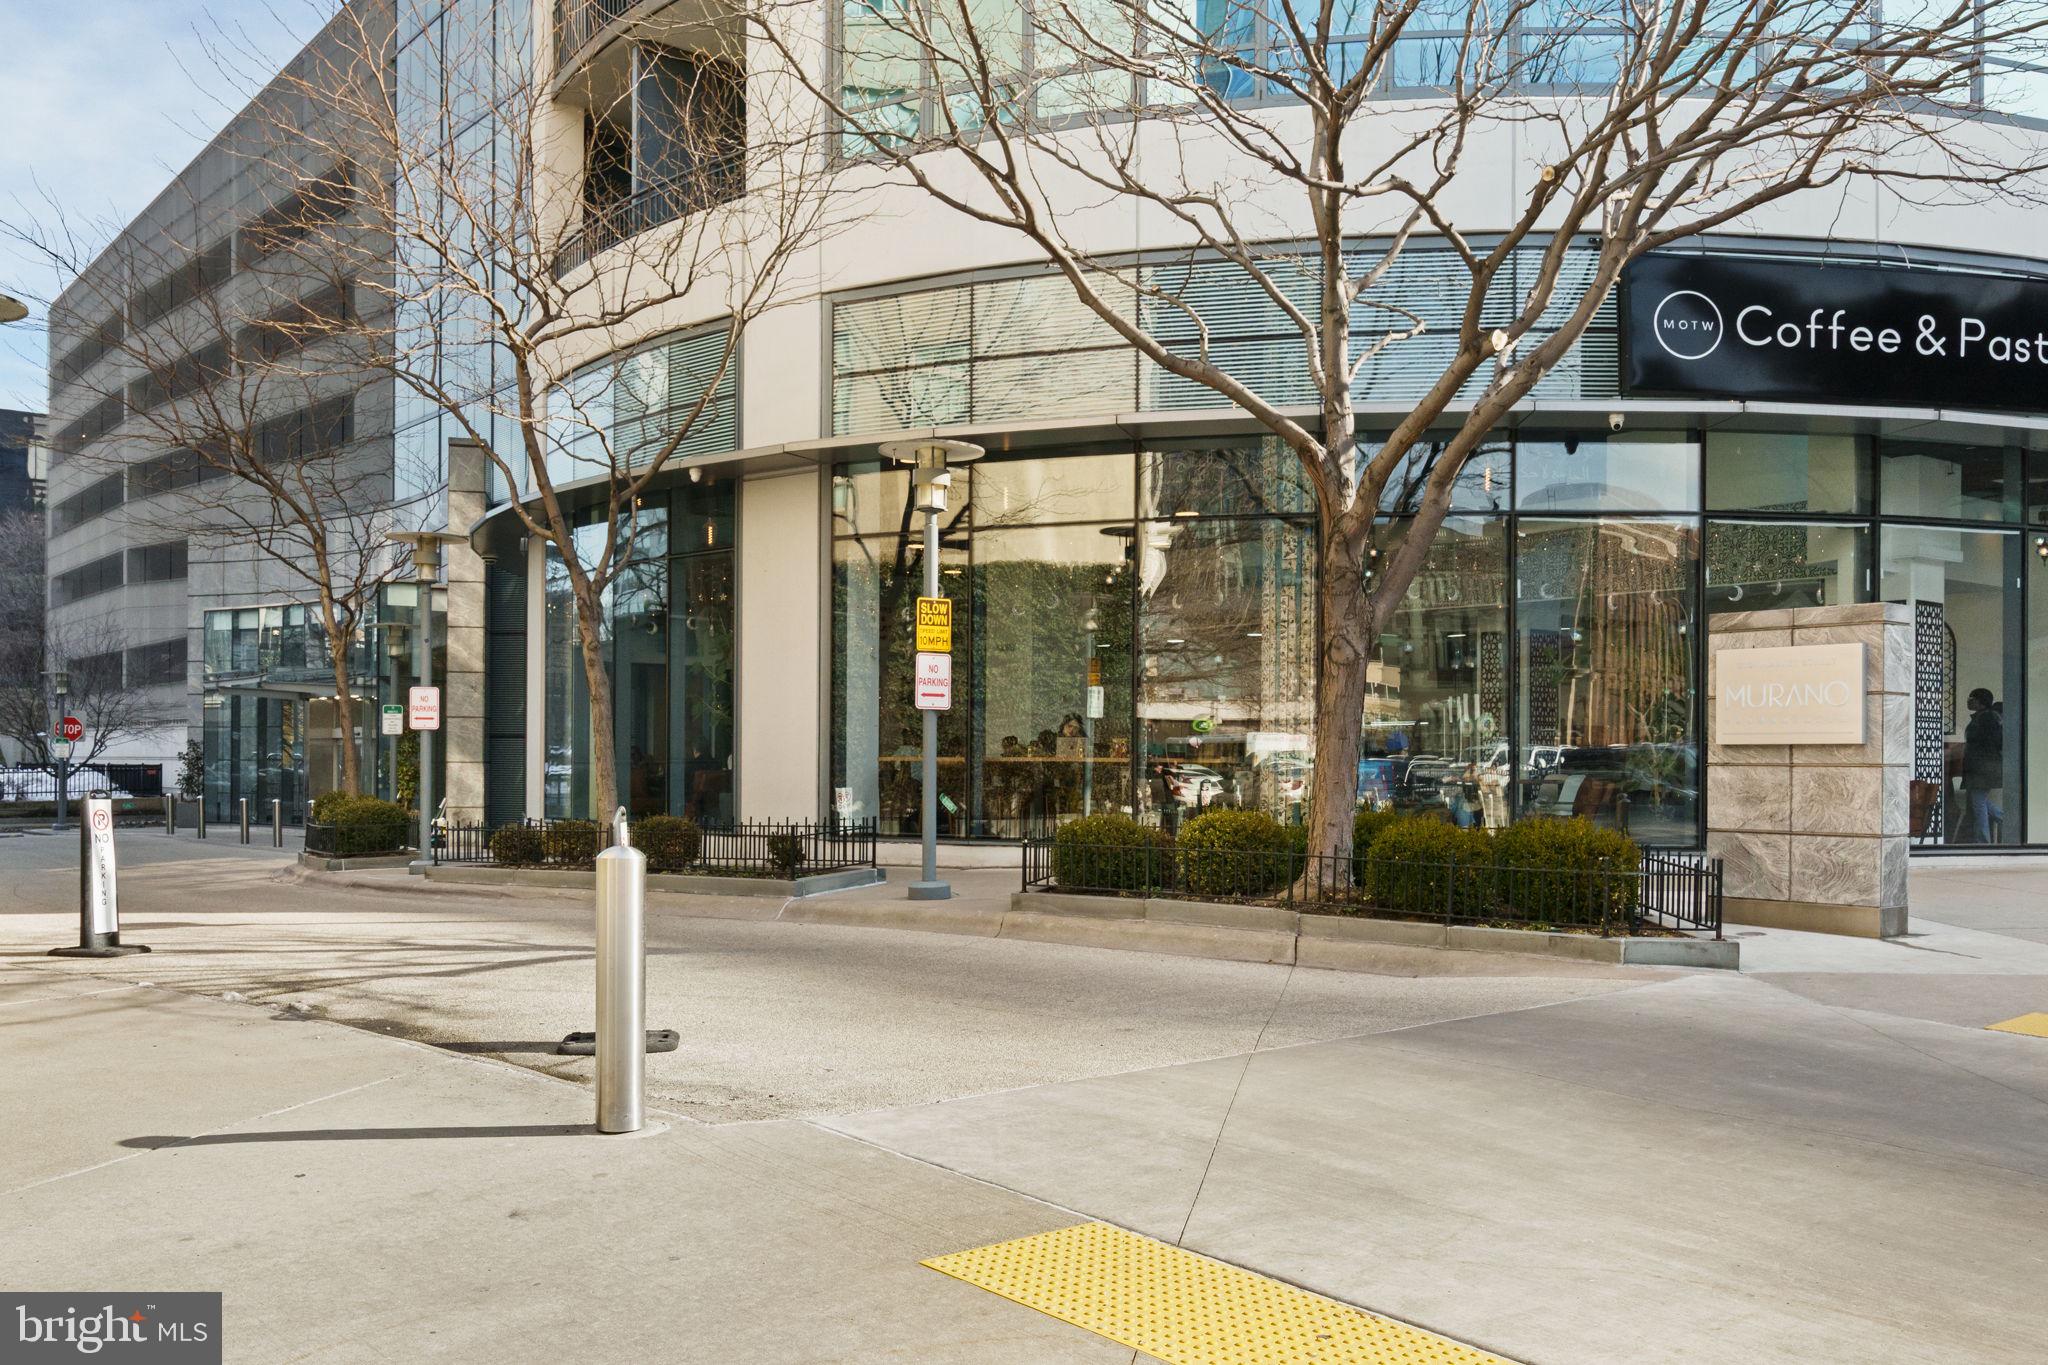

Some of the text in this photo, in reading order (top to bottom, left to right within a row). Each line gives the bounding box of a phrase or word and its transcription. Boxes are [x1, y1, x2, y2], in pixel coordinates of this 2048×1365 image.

[1663, 319, 1715, 332] MOTW
[1736, 305, 2048, 364] Coffee & Past
[920, 602, 948, 614] SLOW
[920, 614, 948, 626] DOWN
[928, 664, 939, 674] NO
[918, 677, 949, 688] PARKING
[420, 695, 429, 703] NO
[1725, 680, 1850, 708] MURANO
[94, 833, 109, 844] NO
[100, 846, 108, 906] PARKING
